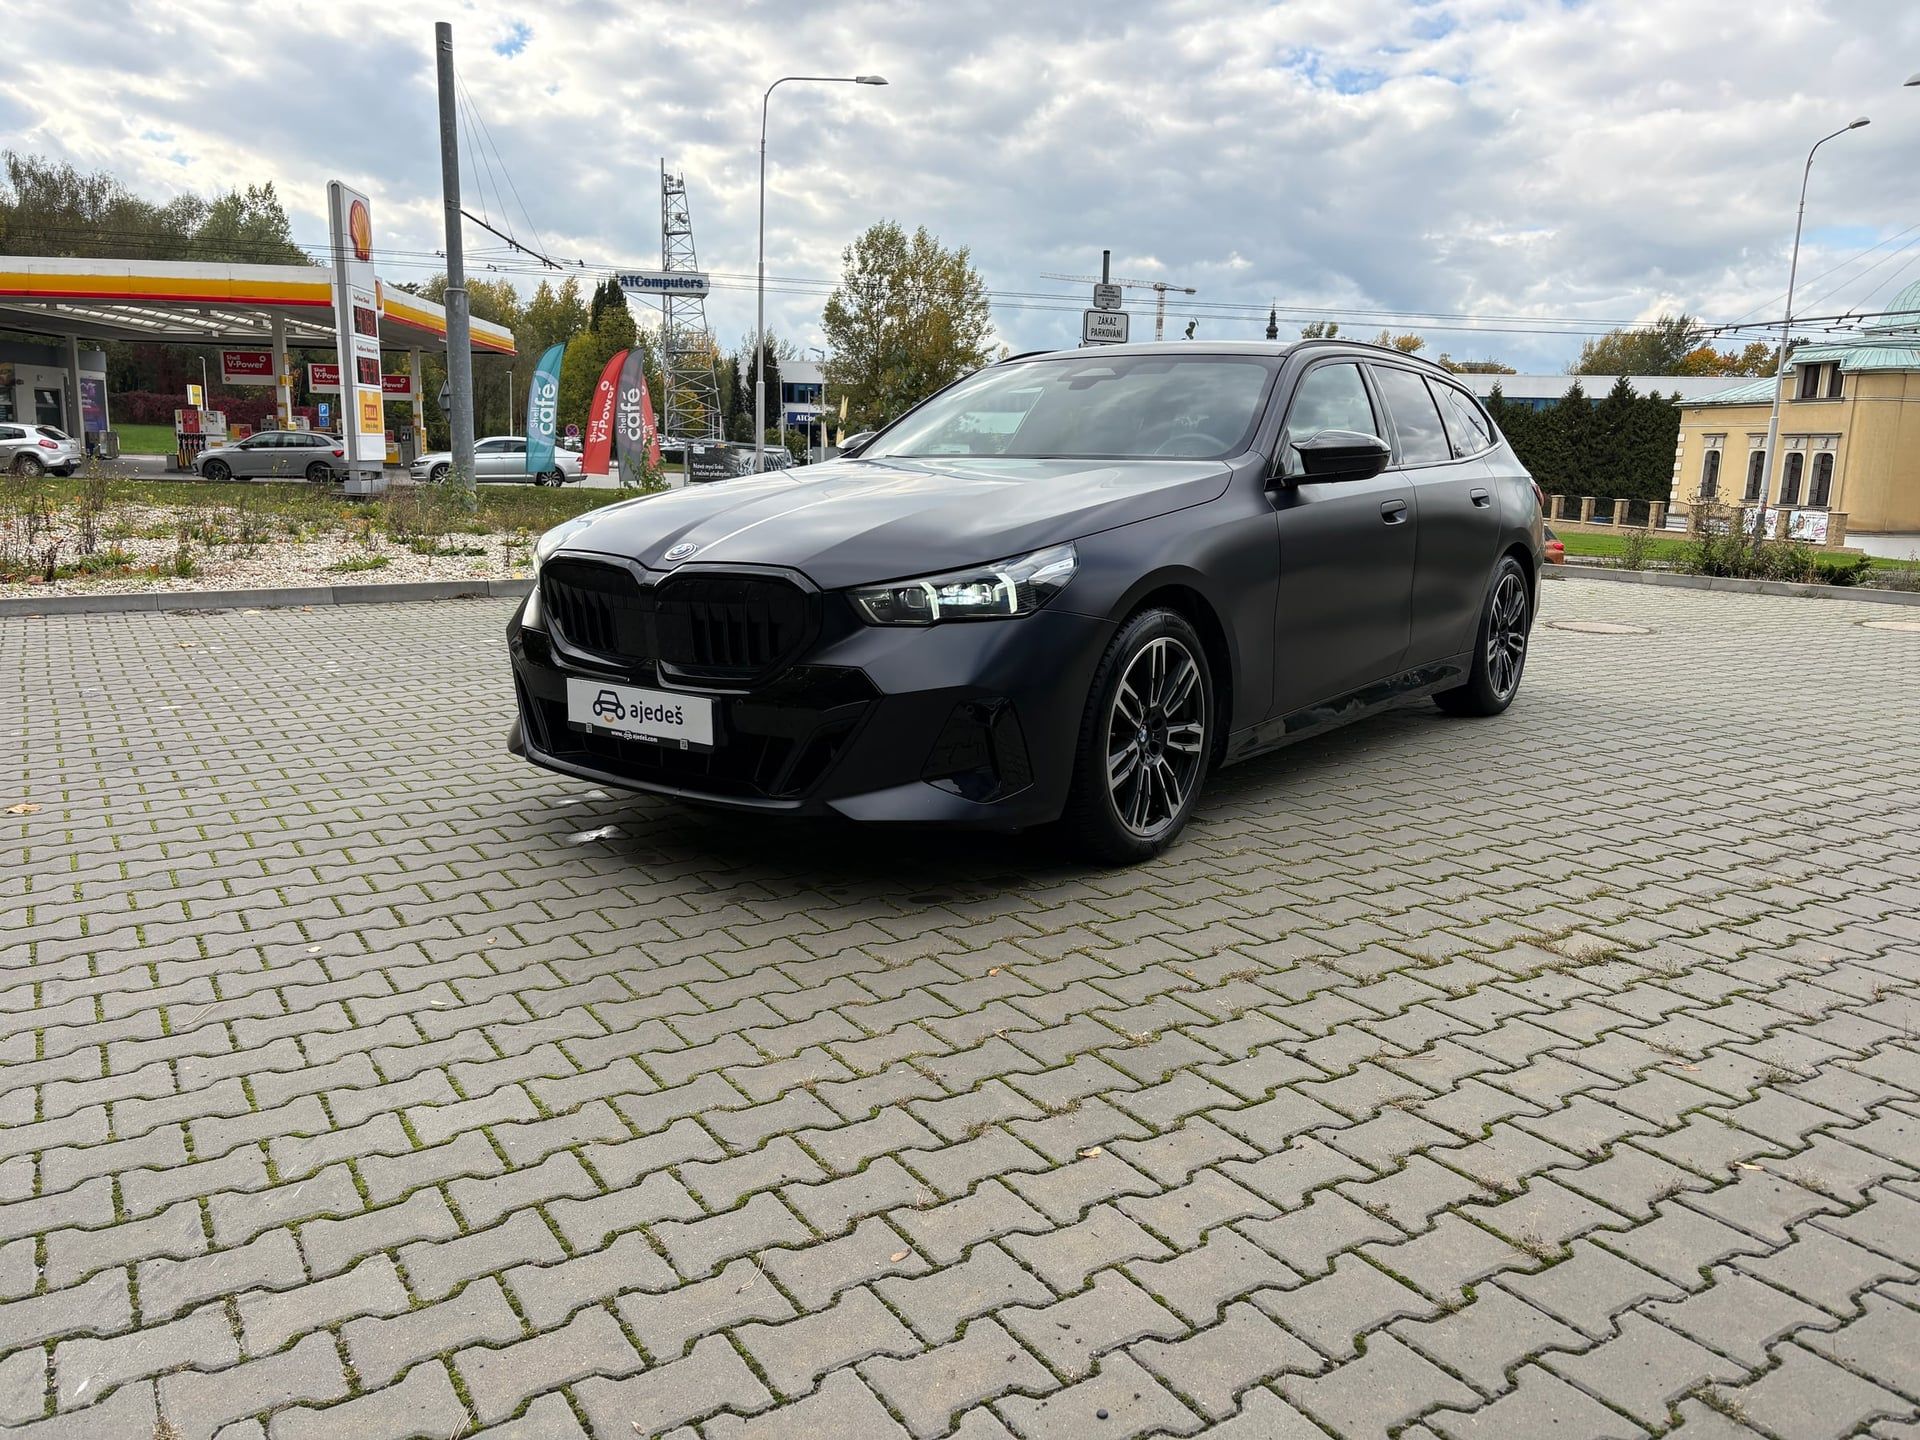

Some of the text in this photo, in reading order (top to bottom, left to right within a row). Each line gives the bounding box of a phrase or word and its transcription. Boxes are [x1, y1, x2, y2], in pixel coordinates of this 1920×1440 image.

[620, 275, 704, 290] ATComputers
[1097, 314, 1117, 326] ZÁKAZ
[1090, 327, 1123, 338] PARKOVÁNÍ
[529, 407, 540, 428] Shell
[534, 383, 556, 436] café
[620, 387, 641, 441] café
[589, 420, 599, 443] Shell
[618, 412, 627, 434] Shell
[630, 700, 684, 725] ajedeš
